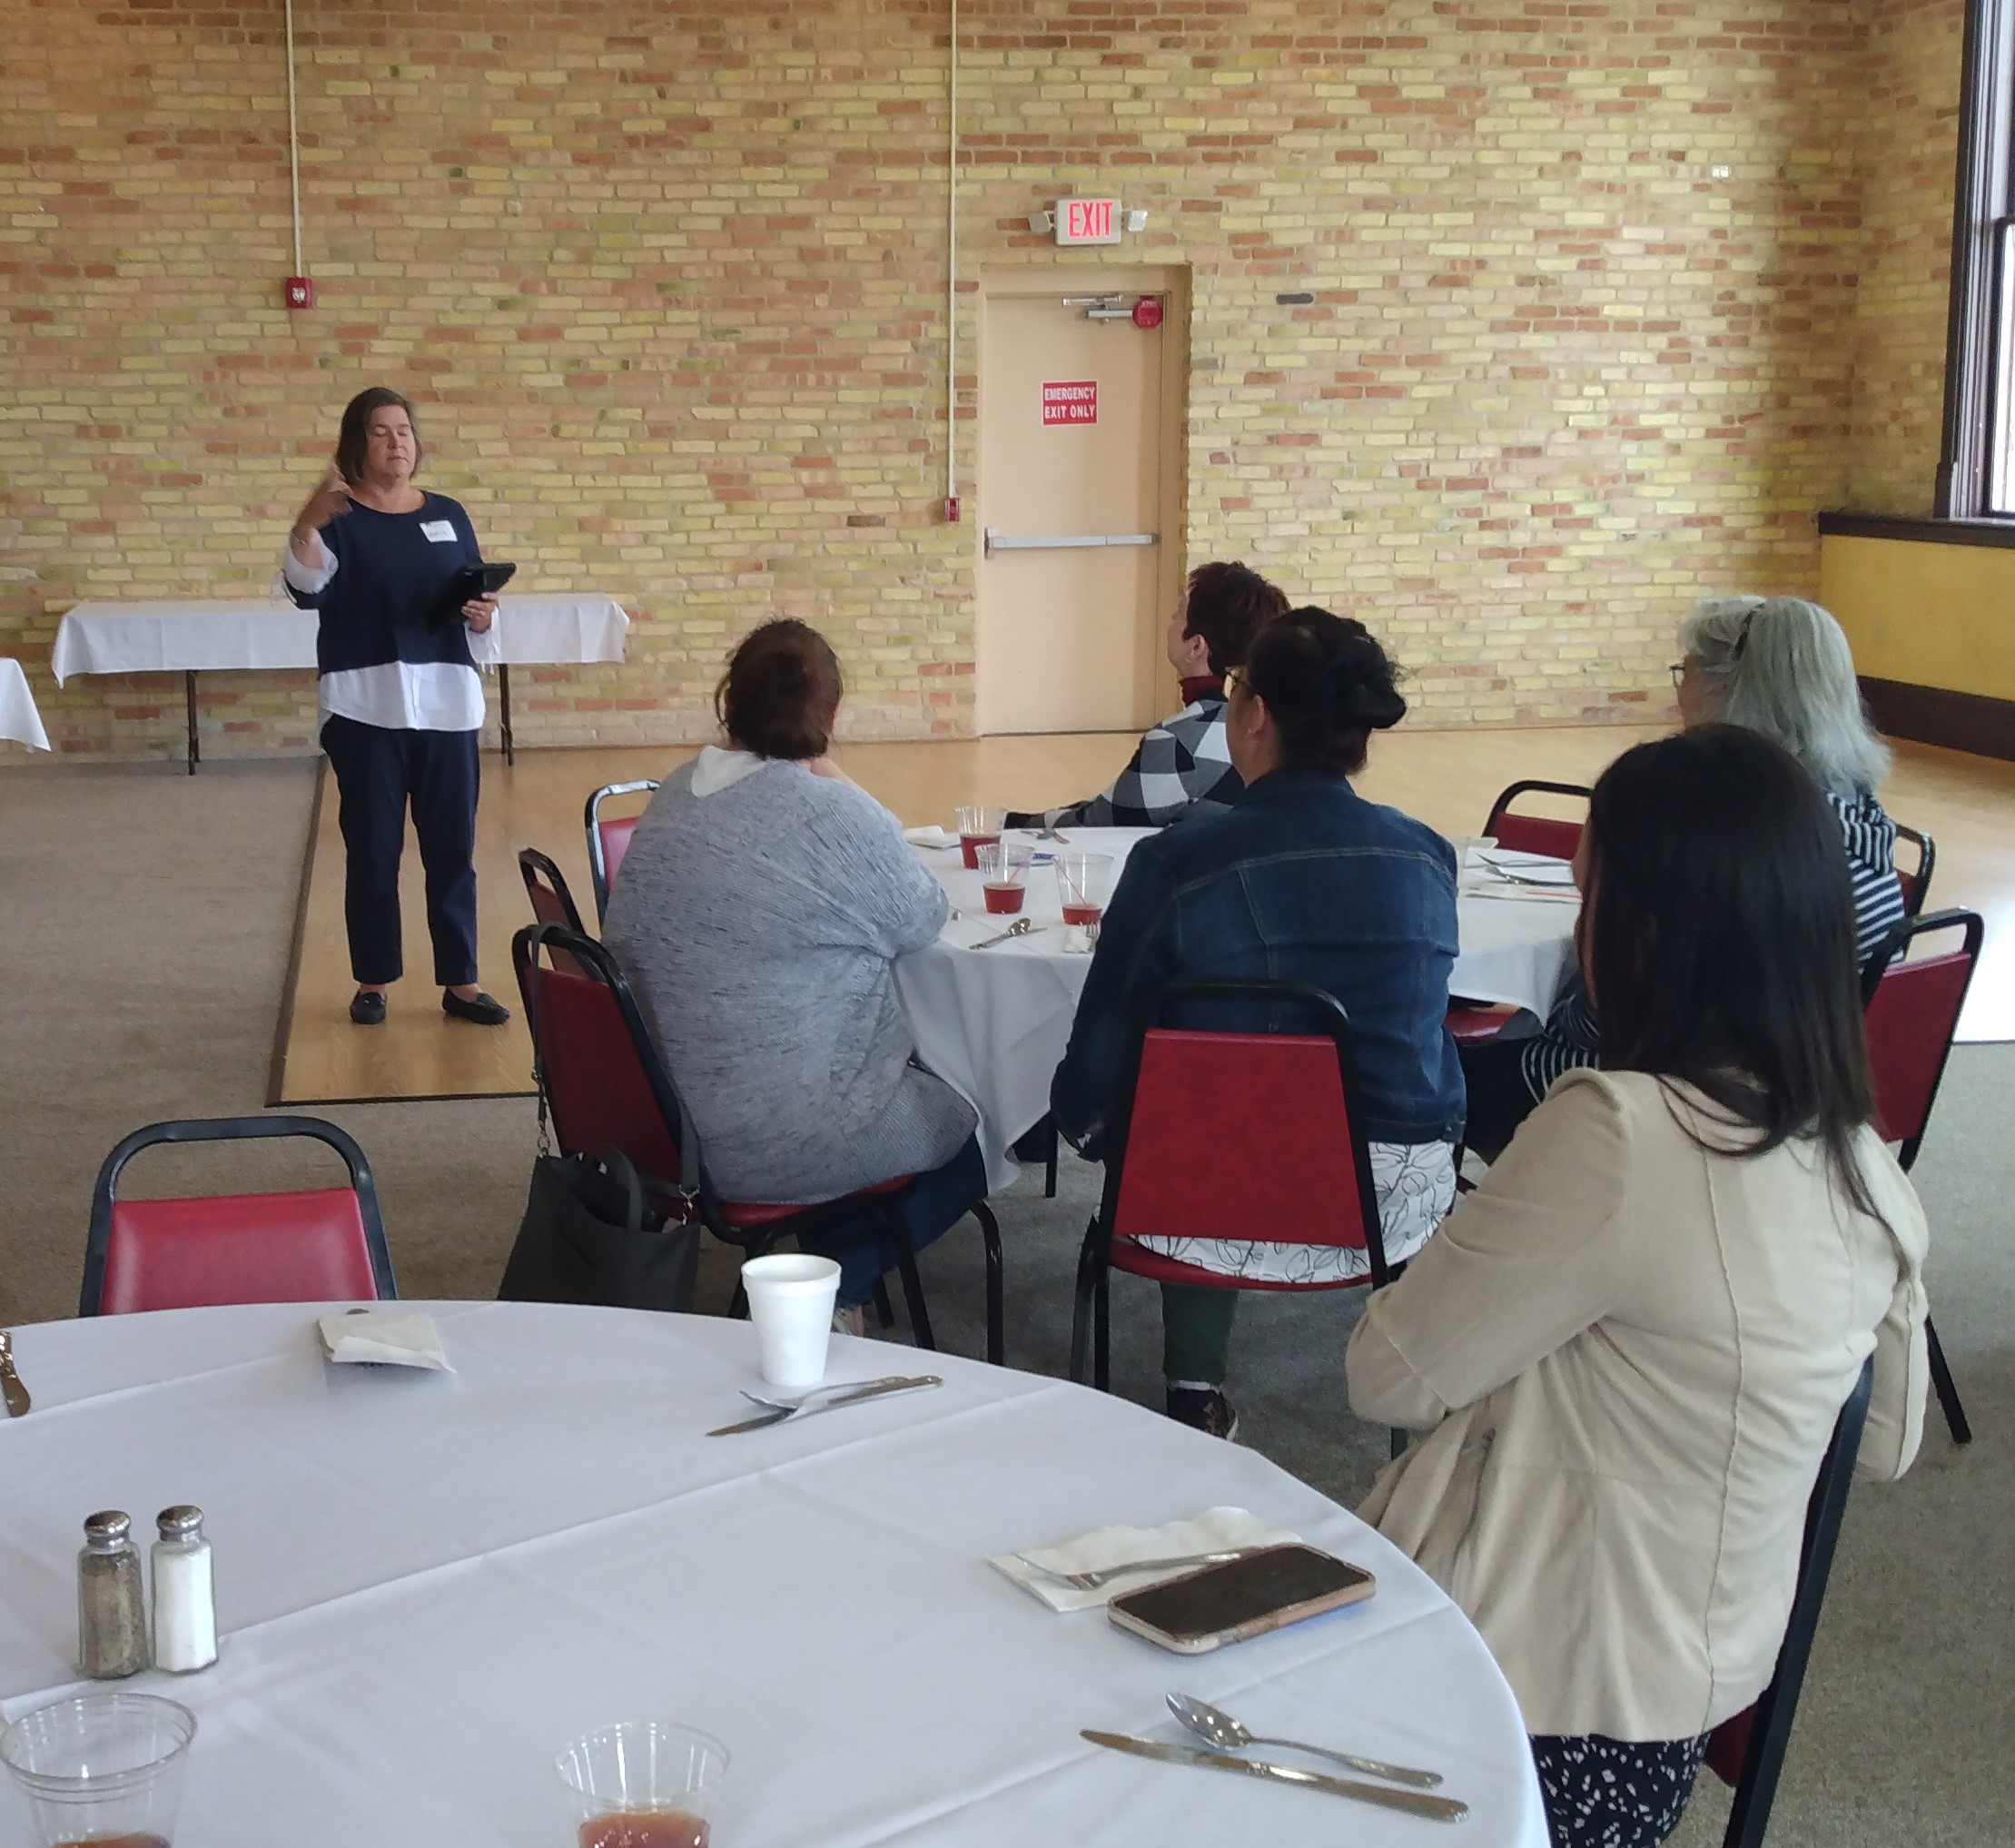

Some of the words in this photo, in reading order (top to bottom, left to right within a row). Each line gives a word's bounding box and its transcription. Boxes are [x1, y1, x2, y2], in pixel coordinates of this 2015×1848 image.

[1069, 202, 1112, 238] EXIT
[1044, 387, 1095, 400] EMERGENCY
[1044, 405, 1066, 419] EXIT
[1070, 404, 1095, 418] ONLY
